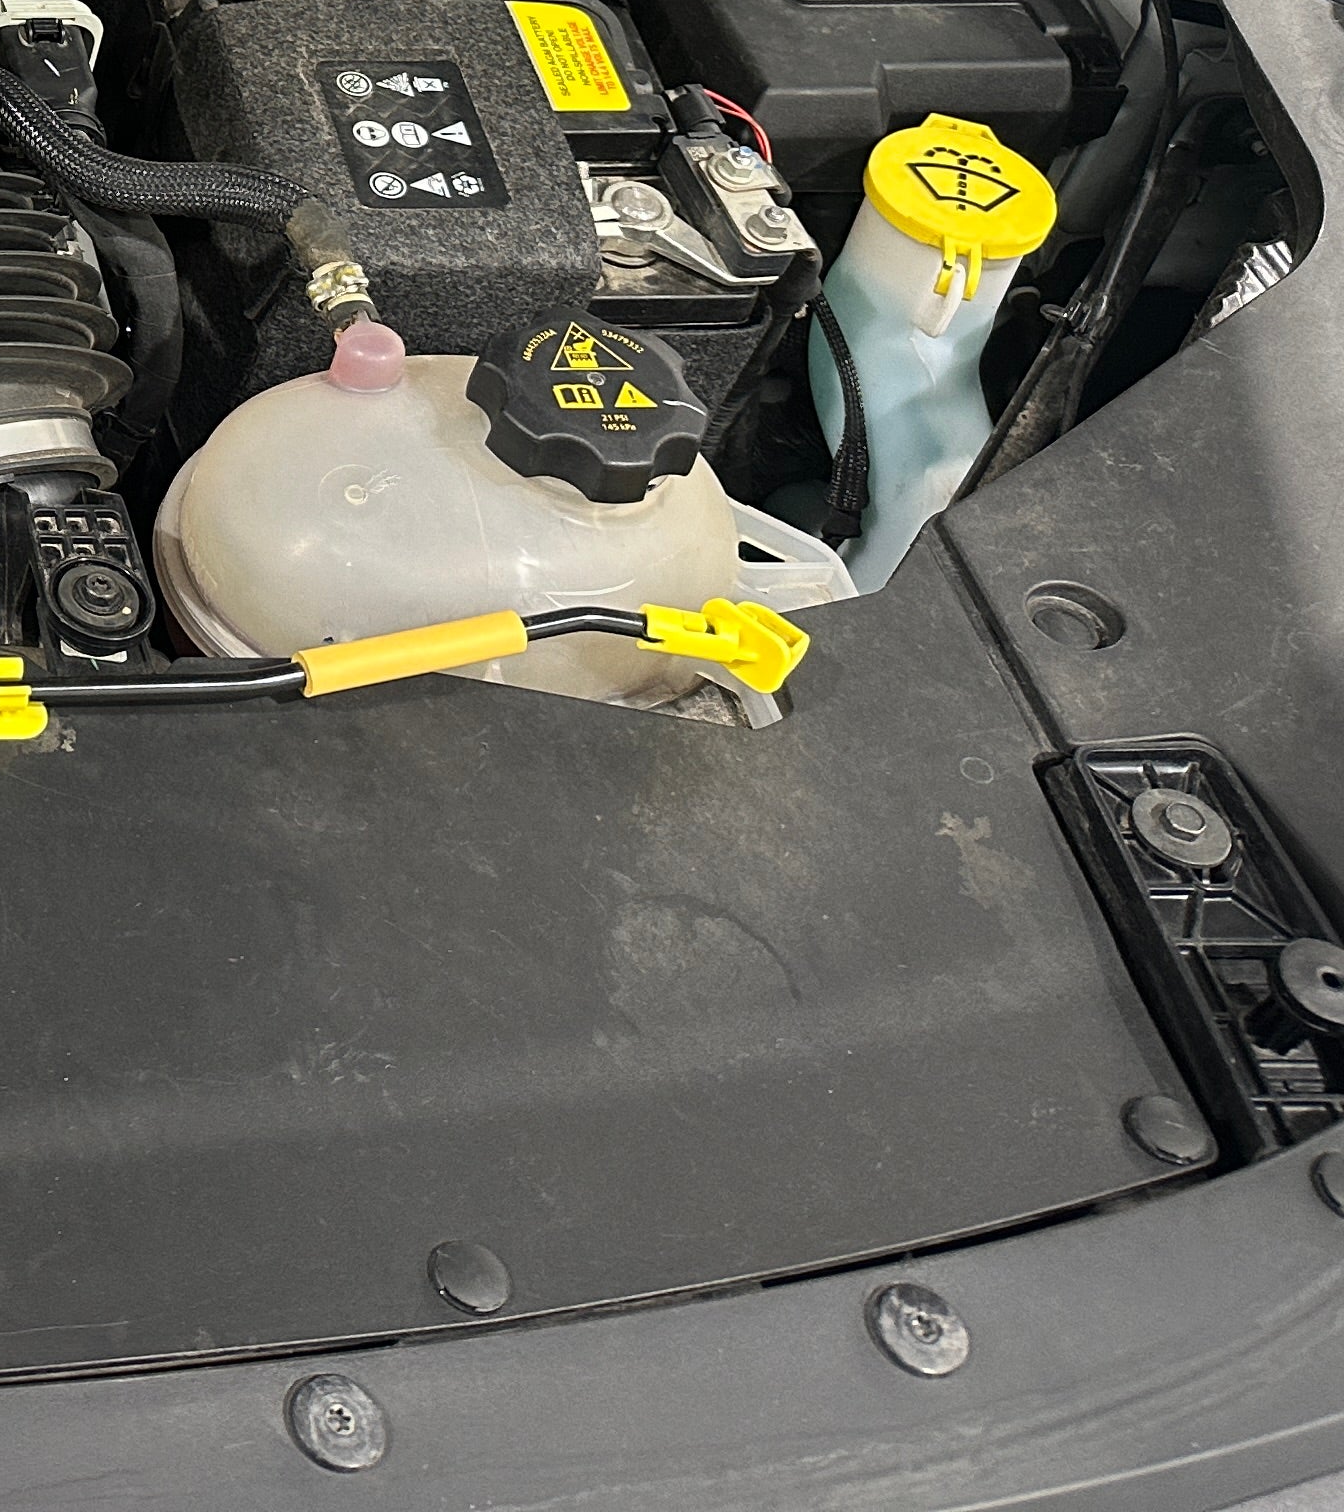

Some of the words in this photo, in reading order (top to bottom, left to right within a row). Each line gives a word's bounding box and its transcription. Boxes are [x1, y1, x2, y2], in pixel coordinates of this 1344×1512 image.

[528, 16, 548, 48] BATTERY
[550, 66, 571, 96] SEALED
[564, 70, 575, 81] DO
